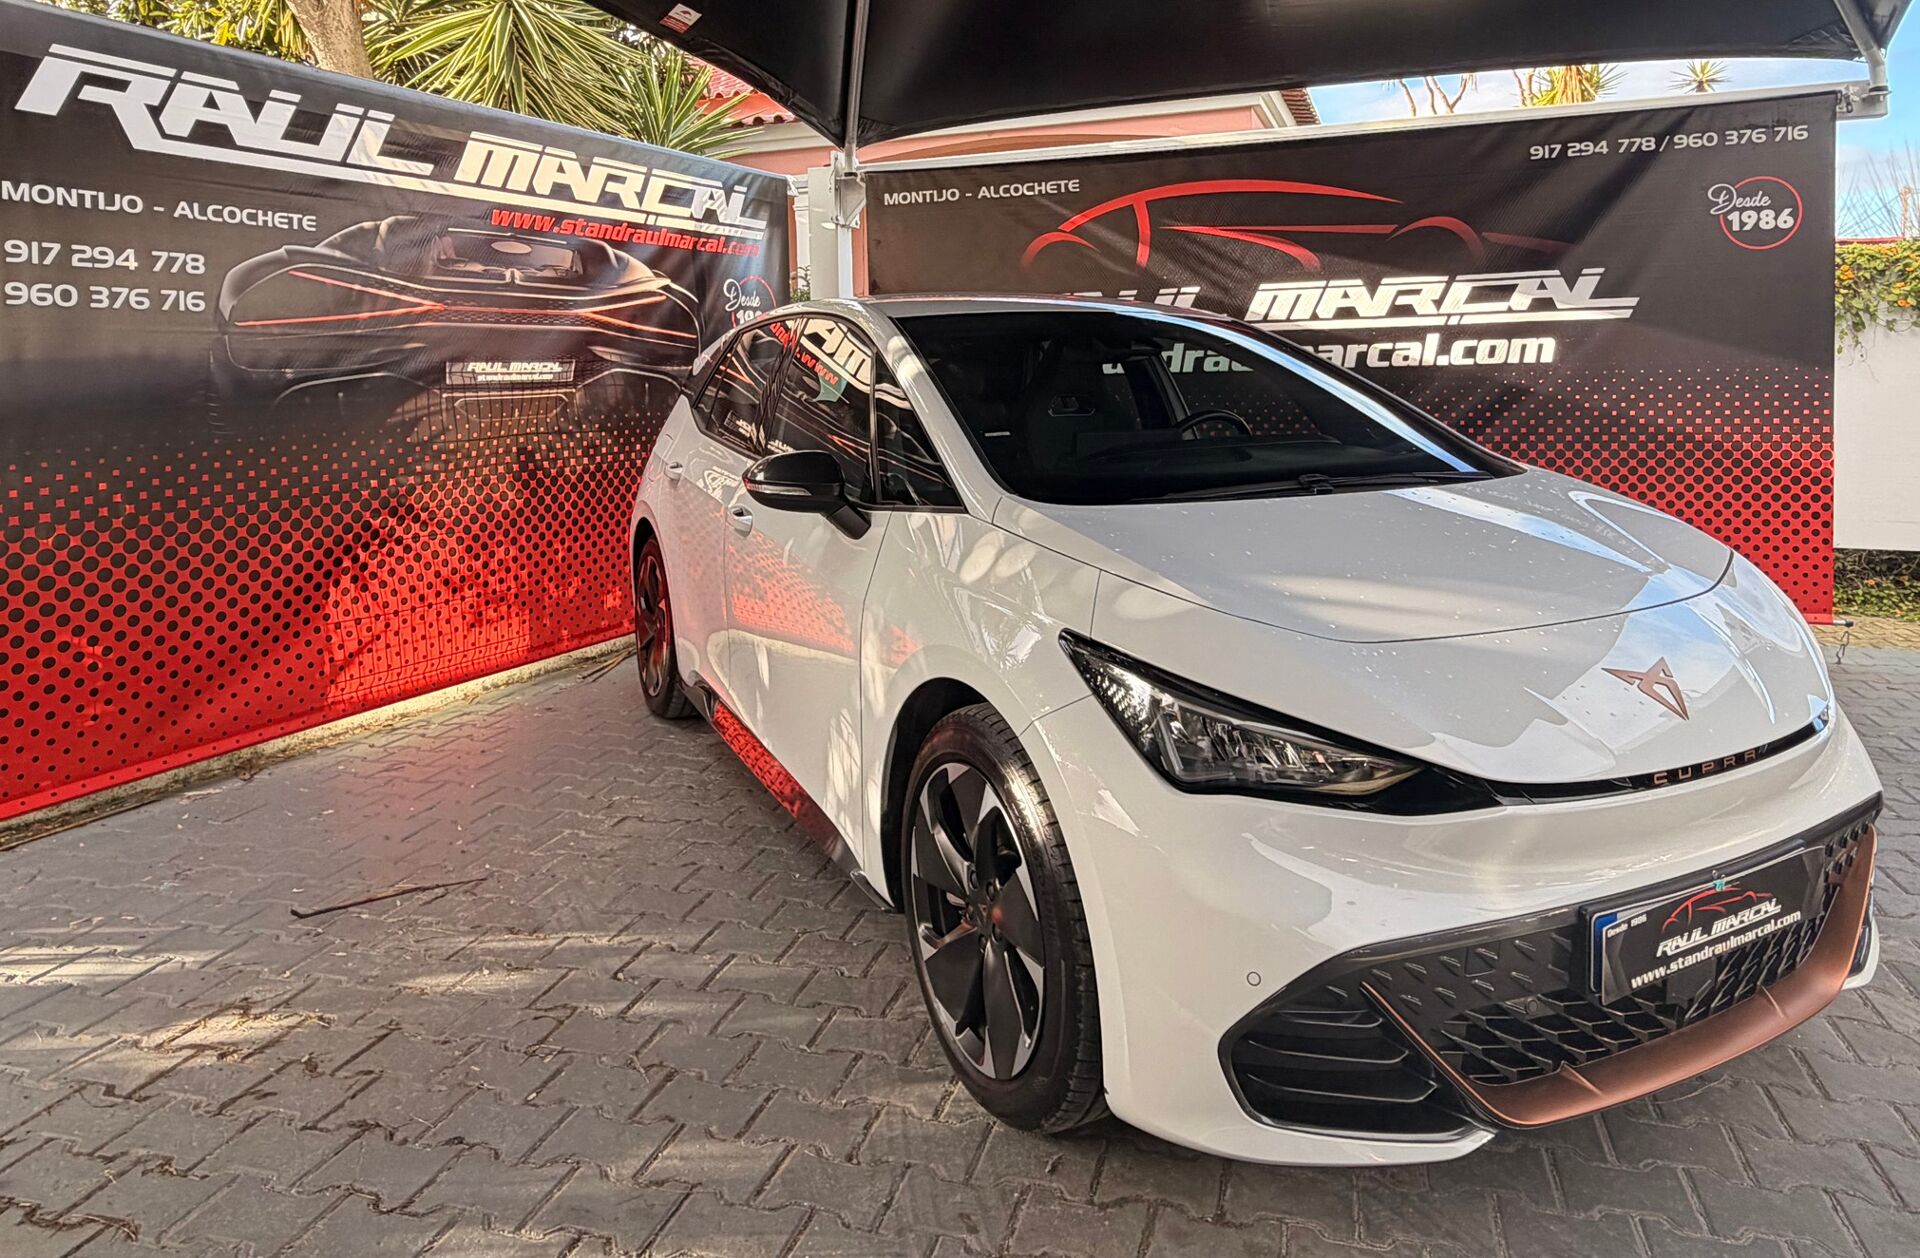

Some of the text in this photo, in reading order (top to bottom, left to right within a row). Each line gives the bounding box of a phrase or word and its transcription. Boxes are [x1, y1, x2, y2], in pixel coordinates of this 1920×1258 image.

[1530, 144, 1561, 160] 917
[1567, 141, 1608, 157] 294
[1618, 137, 1656, 153] 778
[1674, 132, 1718, 148] 960
[1725, 128, 1767, 145] 376
[1774, 125, 1808, 142] 716
[0, 180, 144, 214] MONTIJO
[173, 200, 317, 232] ALCOCHETE
[884, 188, 959, 206] MONTIJO
[978, 179, 1080, 199] ALCOCHETE
[1707, 183, 1772, 214] Desde
[1727, 207, 1794, 231] 1986
[4, 239, 206, 275] 917 294 778
[4, 281, 206, 312] 960 376 716
[723, 278, 761, 311] Desde
[736, 309, 763, 324] 19
[1653, 749, 1757, 786] CUPRA
[1631, 911, 1802, 990] www.standraulmarcal.com
